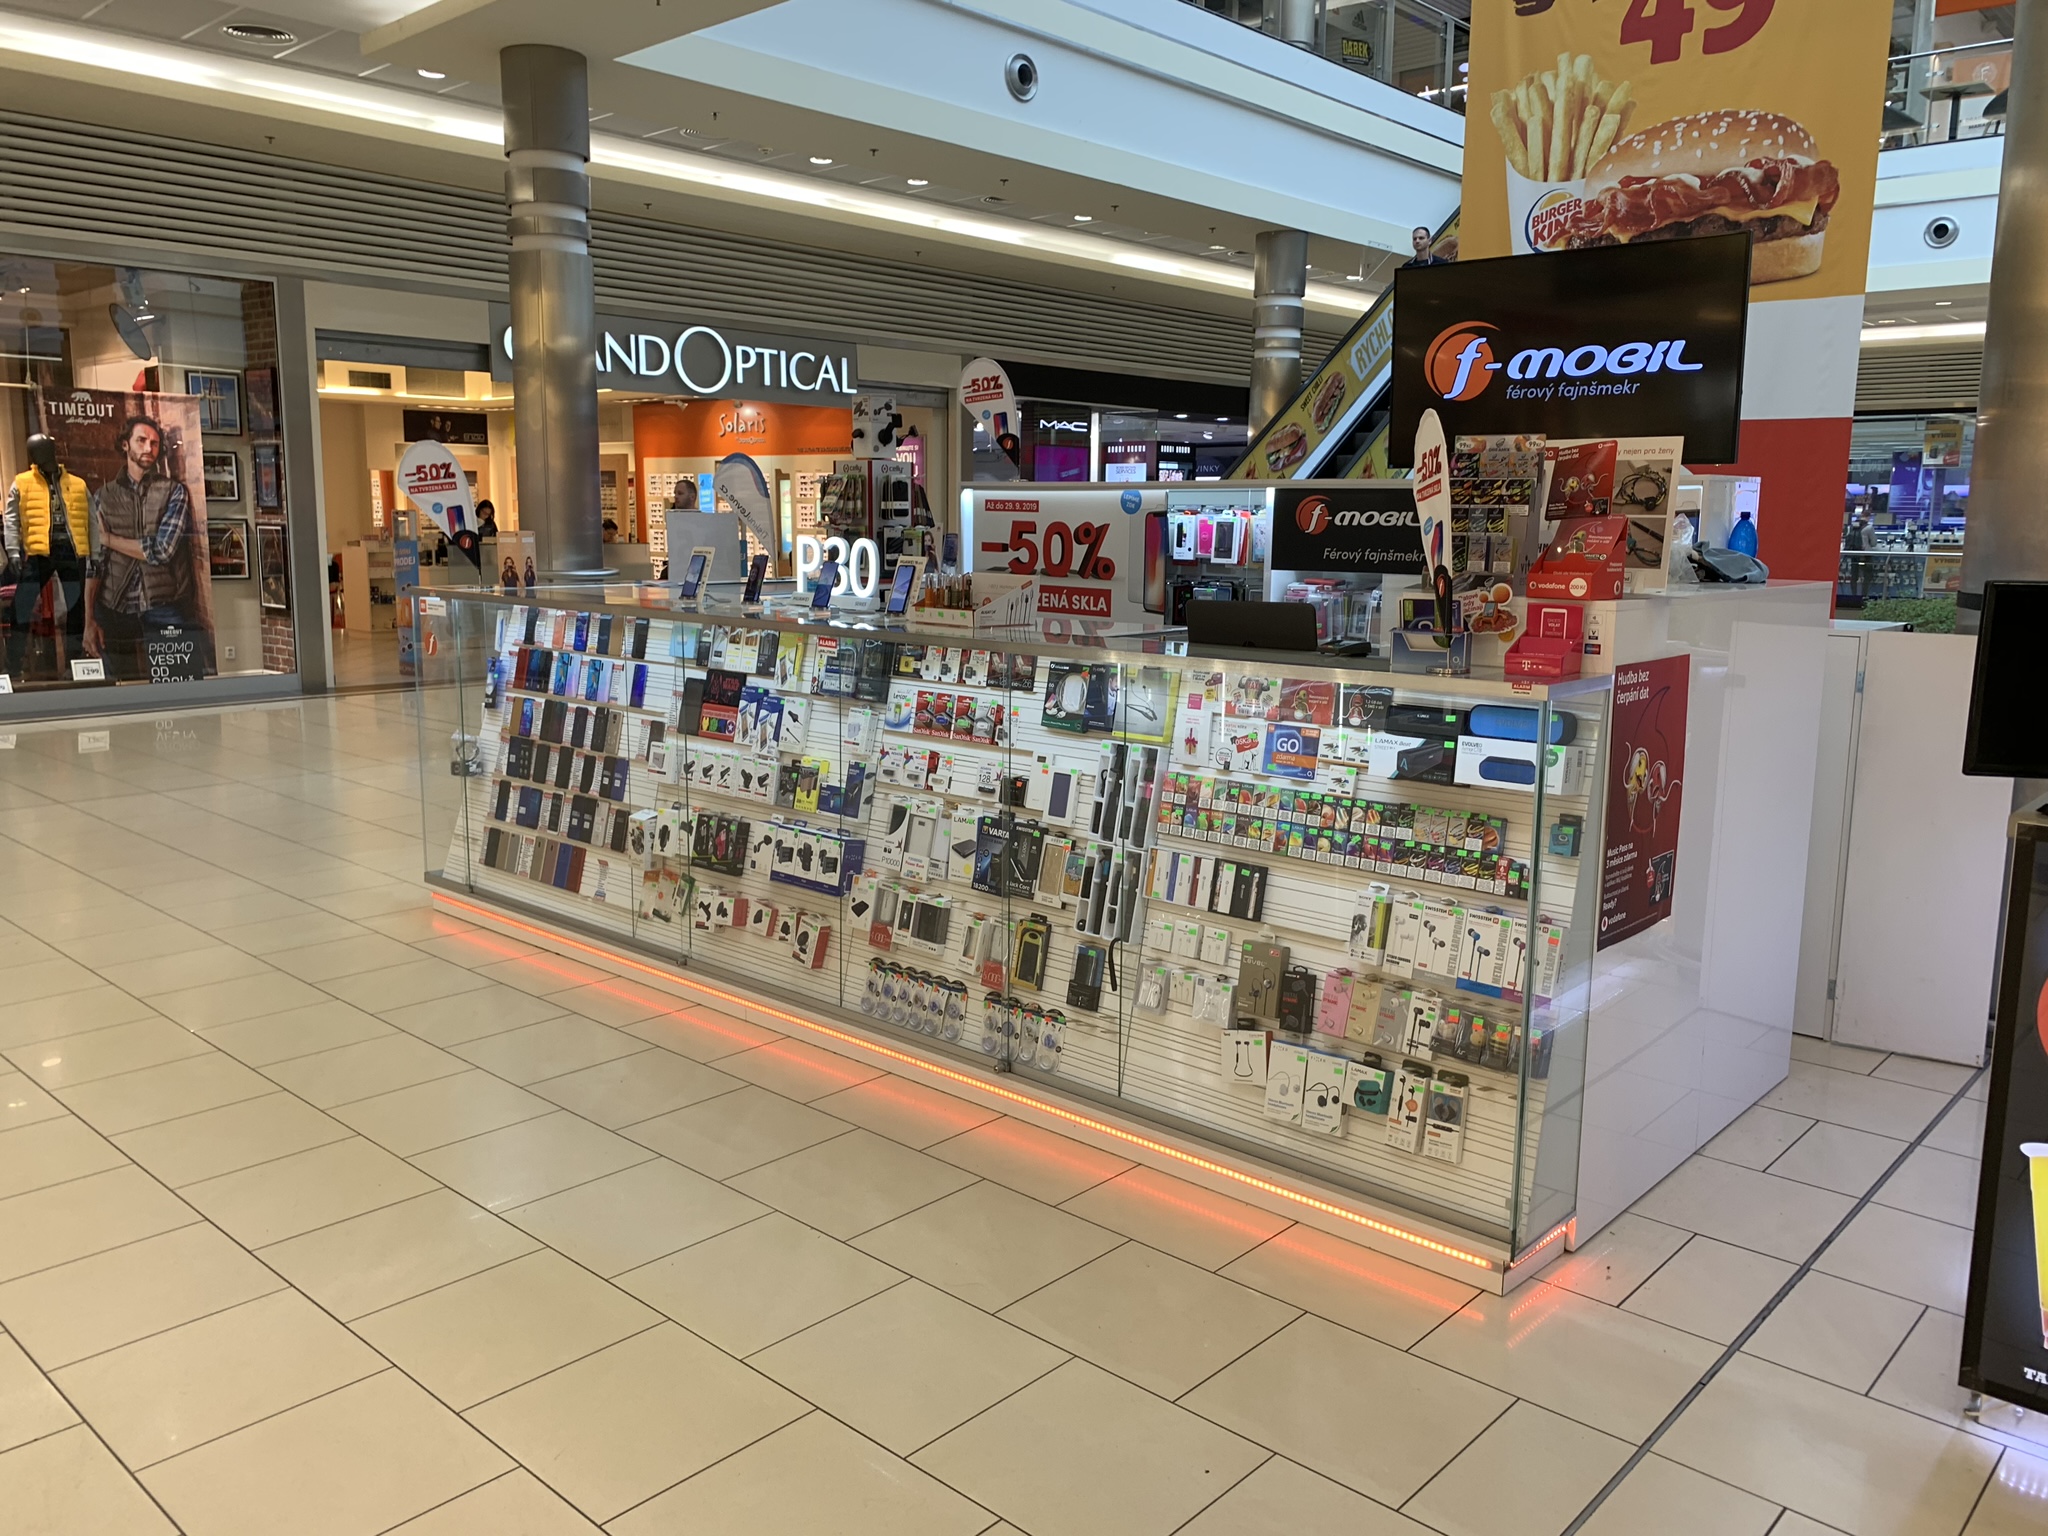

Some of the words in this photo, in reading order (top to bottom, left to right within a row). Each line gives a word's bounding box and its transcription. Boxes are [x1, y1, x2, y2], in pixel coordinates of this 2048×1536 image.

[1531, 198, 1582, 230] BURGER
[1300, 391, 1313, 412] SWEET
[1312, 375, 1324, 395] CHILLI
[1506, 382, 1555, 402] férový
[1557, 379, 1641, 401] fajnšmekr
[48, 401, 115, 417] TIMEOUT
[718, 411, 766, 438] Solaris
[1658, 447, 1675, 455] ženy
[405, 462, 457, 483] -50%
[442, 482, 456, 490] SKLA
[986, 501, 995, 509] Až
[995, 502, 1004, 510] do
[1005, 502, 1015, 510] 29.
[1015, 502, 1022, 510] 9.
[1022, 502, 1037, 511] 2019
[981, 520, 1116, 581] -50%
[1323, 547, 1362, 563] Férový
[1364, 549, 1425, 564] fajnšmekr
[796, 534, 880, 598] P30
[1537, 582, 1566, 590] vodafone
[1072, 594, 1108, 612] SKLA
[148, 641, 194, 653] PROMO
[819, 639, 837, 648] ALARM
[148, 653, 191, 665] VESTY
[151, 666, 170, 678] OD
[1617, 670, 1638, 686] Hudba
[1638, 669, 1650, 682] bez
[1616, 686, 1640, 706] čerpání
[1639, 686, 1650, 700] dat
[913, 727, 930, 736] SanDisk
[931, 729, 949, 738] SanDisk
[1276, 737, 1300, 753] GO
[1374, 738, 1399, 746] LAMAX
[1275, 753, 1296, 761] zdarma
[988, 827, 1010, 839] VARTA
[973, 882, 989, 892] 18200
[1424, 904, 1448, 915] SWISSTEN
[1469, 912, 1492, 923] SWISSTEN
[1495, 927, 1510, 962] EARPHON
